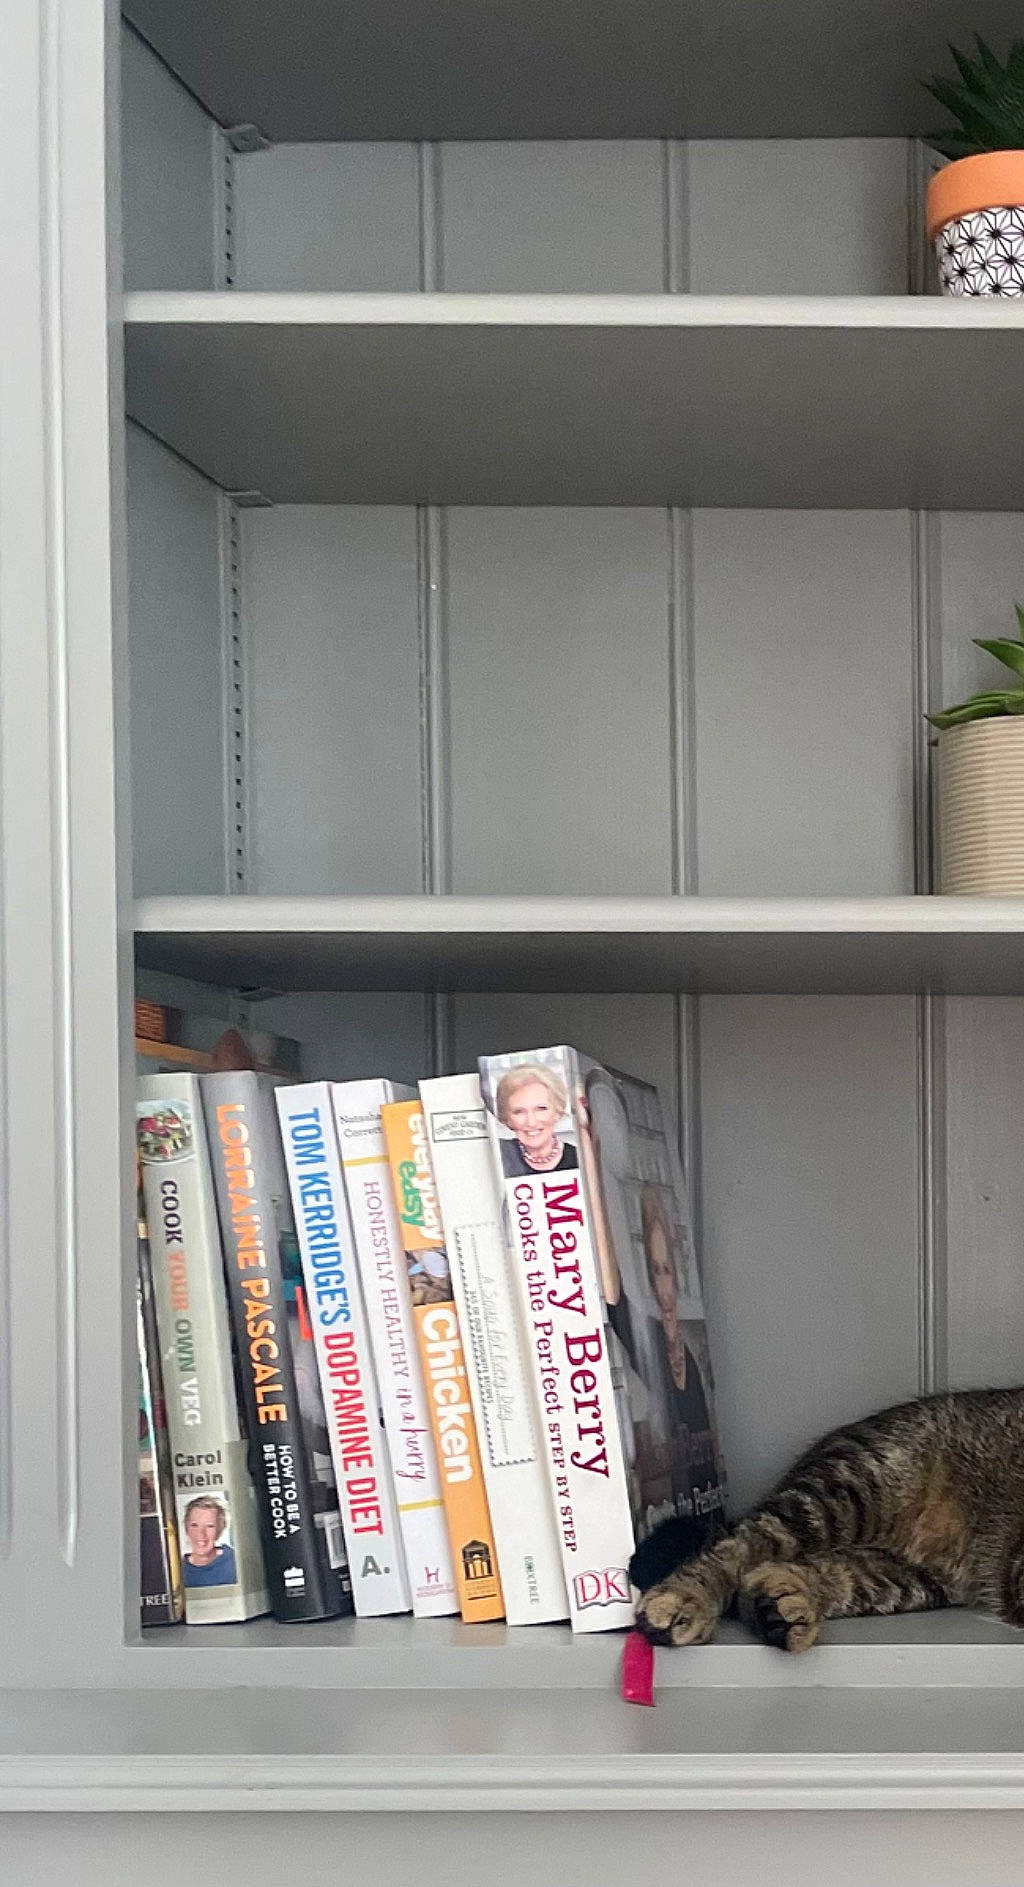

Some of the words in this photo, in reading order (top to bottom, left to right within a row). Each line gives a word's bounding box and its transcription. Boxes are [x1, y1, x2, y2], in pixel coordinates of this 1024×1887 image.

[288, 1108, 326, 1164] TOM
[160, 1180, 184, 1244] COOK
[216, 1104, 266, 1270] LORRAINE
[298, 1171, 351, 1327] KERRIDGE'S
[513, 1183, 542, 1263] Cooks
[542, 1178, 587, 1317] Mary
[167, 1251, 189, 1312] YOUR
[526, 1270, 547, 1312] the
[175, 1319, 196, 1372] OWN
[240, 1278, 288, 1425] PASCALE
[364, 1182, 395, 1282] HONESTLY
[381, 1289, 409, 1378] HEALTHY
[395, 1428, 429, 1482] hurry
[534, 1320, 564, 1415] Perfect
[179, 1379, 201, 1426] VEG
[324, 1332, 374, 1472] DOPAMINE
[423, 1309, 473, 1484] Chicken
[564, 1328, 610, 1479] Berry
[174, 1450, 222, 1467] Carol
[279, 1445, 295, 1477] HOW
[548, 1422, 566, 1469] STEP
[176, 1471, 223, 1487] Klein
[263, 1444, 281, 1495] BETTER
[272, 1497, 287, 1539] COOK
[284, 1482, 298, 1500] TO
[346, 1477, 384, 1536] DIET
[556, 1477, 571, 1499] BY
[287, 1503, 300, 1521] BE
[289, 1524, 301, 1535] A
[560, 1505, 578, 1553] STEP
[578, 1571, 627, 1603] DK
